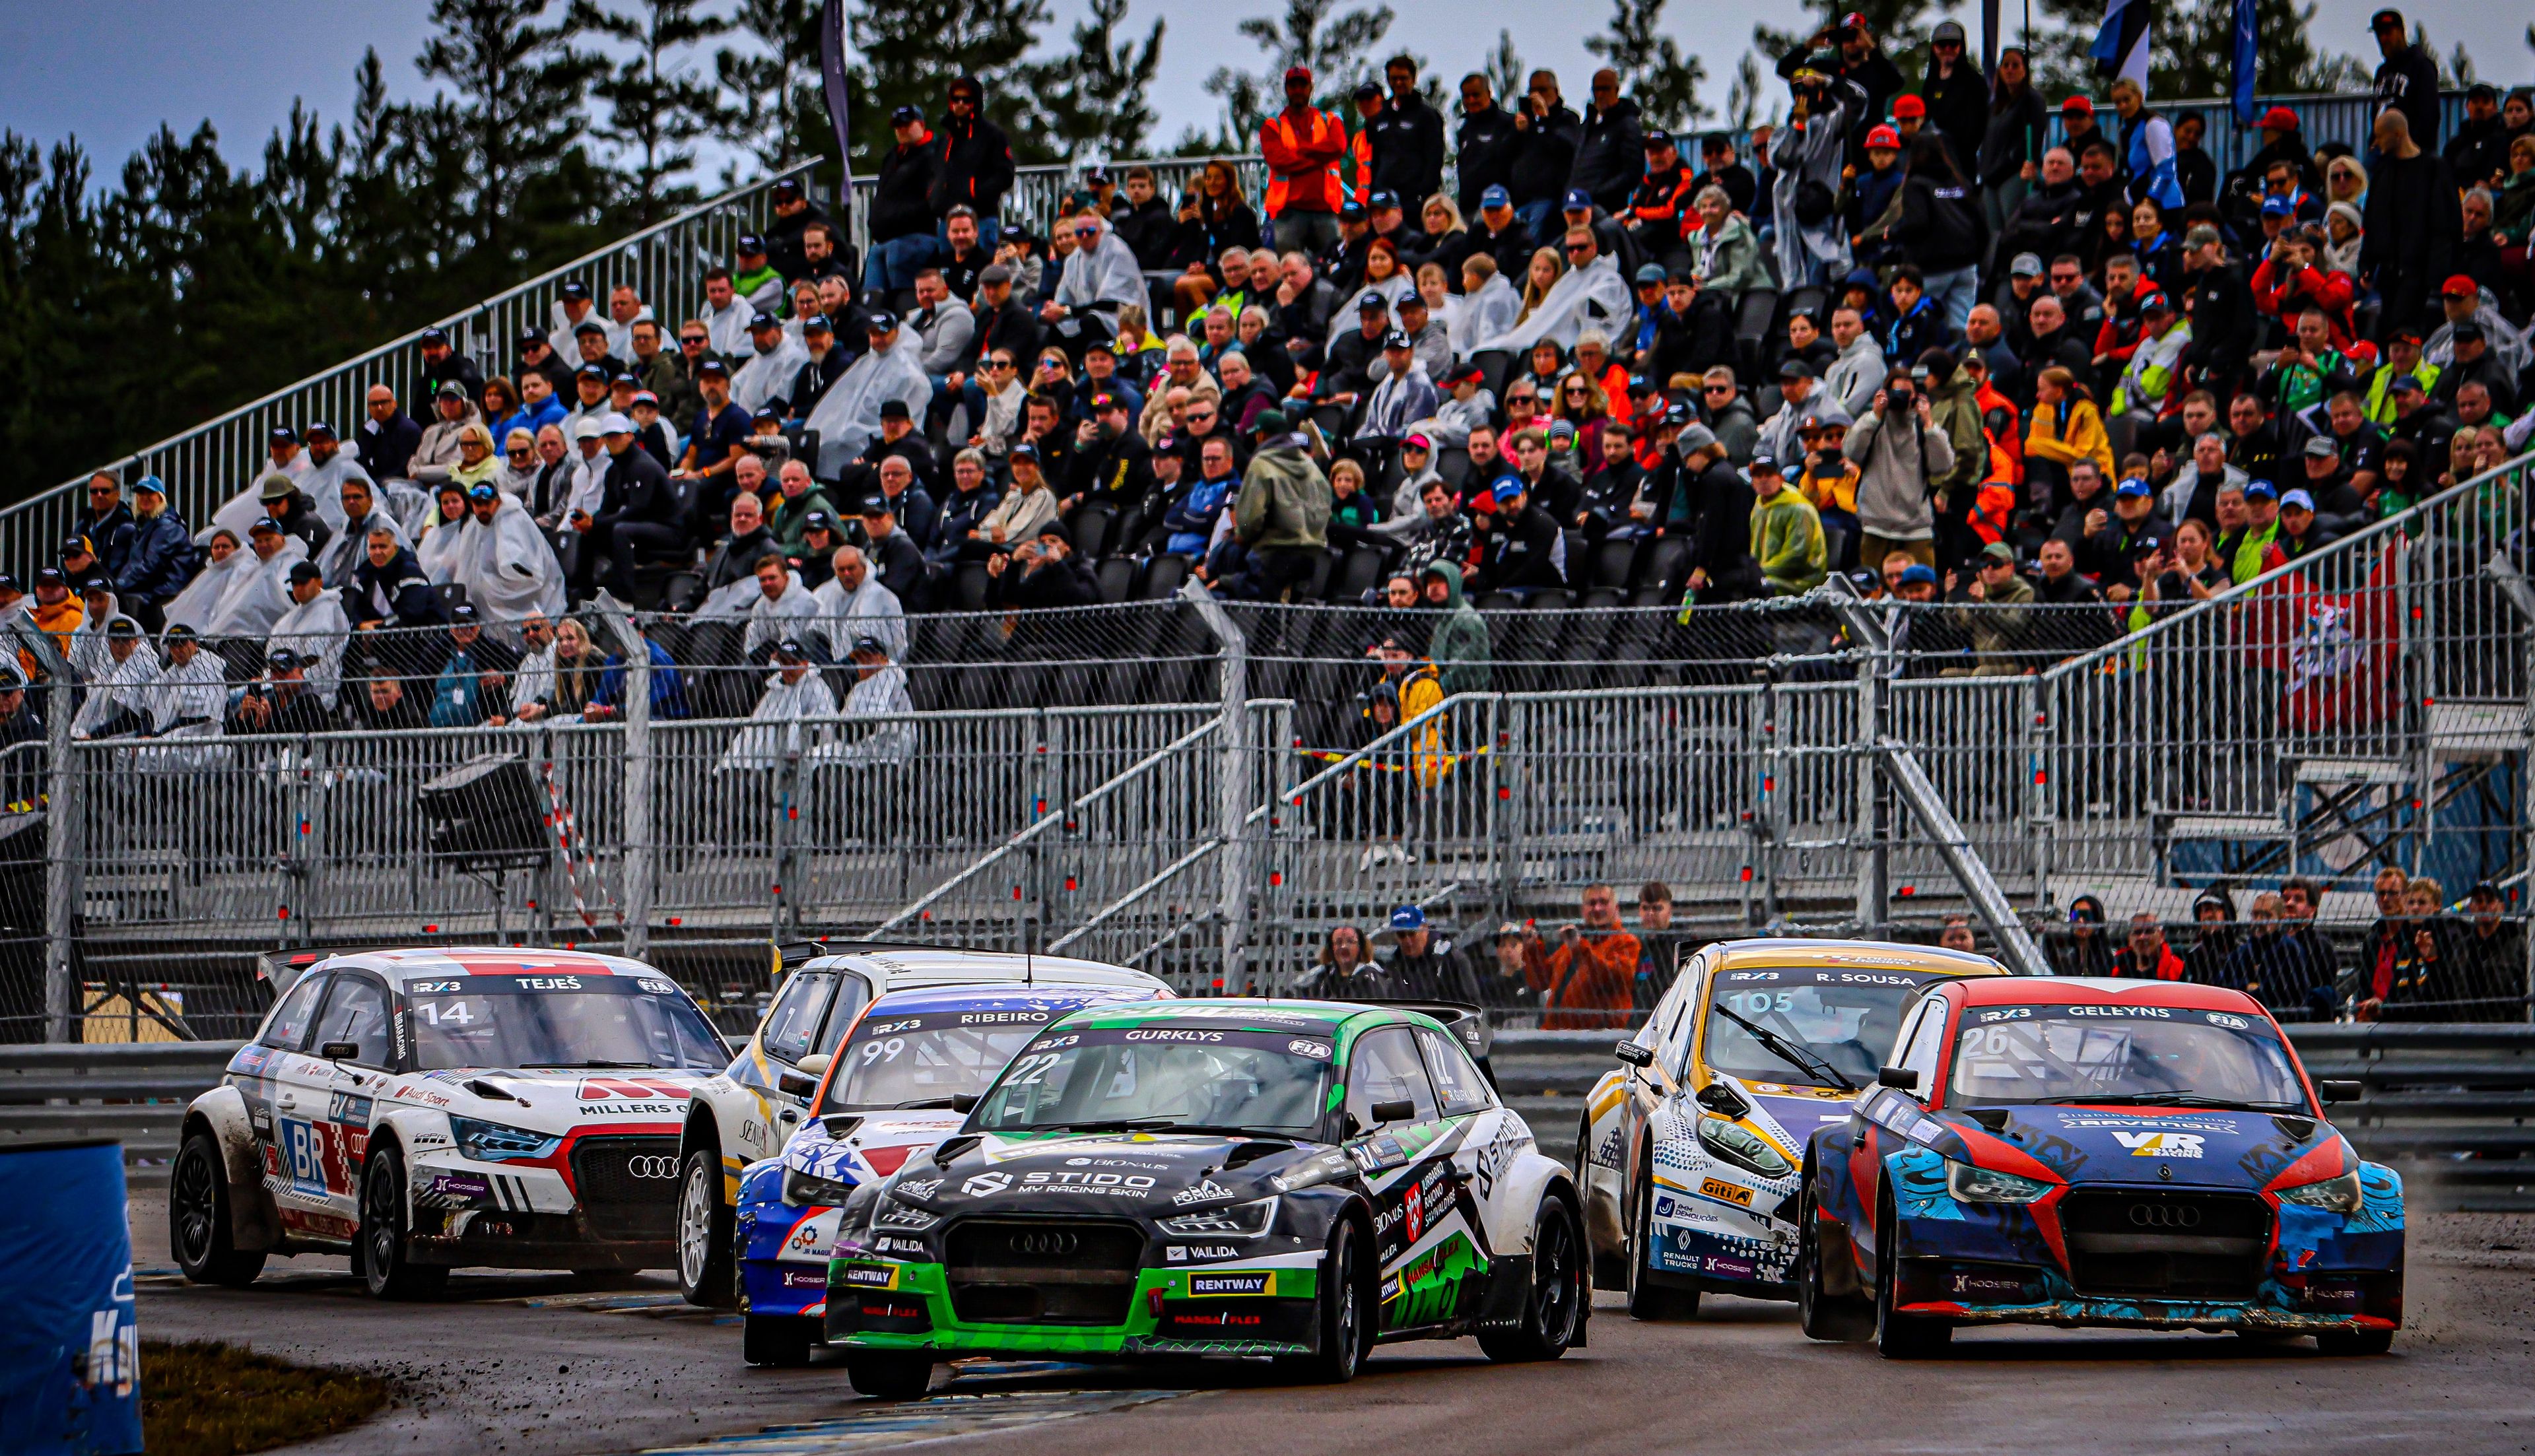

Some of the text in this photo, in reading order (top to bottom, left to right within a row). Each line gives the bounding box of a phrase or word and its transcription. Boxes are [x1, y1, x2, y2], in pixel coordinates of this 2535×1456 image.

[516, 976, 582, 990] TEJEŠ
[1738, 972, 1780, 980] RX3
[1817, 973, 1916, 986] R. SOUSA
[420, 981, 461, 993] RX3
[642, 980, 671, 993] FIA
[1729, 992, 1793, 1013] 105
[419, 1001, 474, 1025] 14
[961, 1012, 1049, 1024] RIBEIRO
[1987, 1008, 2031, 1022] RX3
[2068, 1006, 2171, 1018] GELEYNS
[879, 1019, 922, 1034] RX3
[2212, 1014, 2243, 1028] FIA
[394, 1012, 407, 1060] BIBARACING
[1038, 1035, 1079, 1049] RX3
[1126, 1030, 1224, 1042] GURKLYS
[1963, 1025, 2008, 1059] 26
[863, 1037, 906, 1067] 99
[1291, 1040, 1328, 1057] FIA
[1421, 1032, 1454, 1085] 22
[1001, 1053, 1062, 1087] 22
[405, 1088, 450, 1107] Audi Sport
[579, 1104, 672, 1115] MILLERS
[2111, 1131, 2206, 1150] VR
[294, 1124, 329, 1183] BR
[1023, 1172, 1157, 1188] STIDO
[1421, 1160, 1444, 1196] JURBARKO
[448, 1183, 485, 1192] HOOSIER
[1046, 1185, 1107, 1195] RACING
[1109, 1189, 1149, 1199] SKIN
[1703, 1181, 1733, 1199] Giti
[1424, 1182, 1444, 1209] RAJONO
[893, 1238, 924, 1253] VAILIDA
[1190, 1246, 1239, 1258] VAILIDA
[1664, 1251, 1700, 1263] RENAULT
[1664, 1259, 1697, 1269] TRUCKS
[1716, 1261, 1751, 1274] HOOSIER
[1196, 1279, 1263, 1290] RENTWAY
